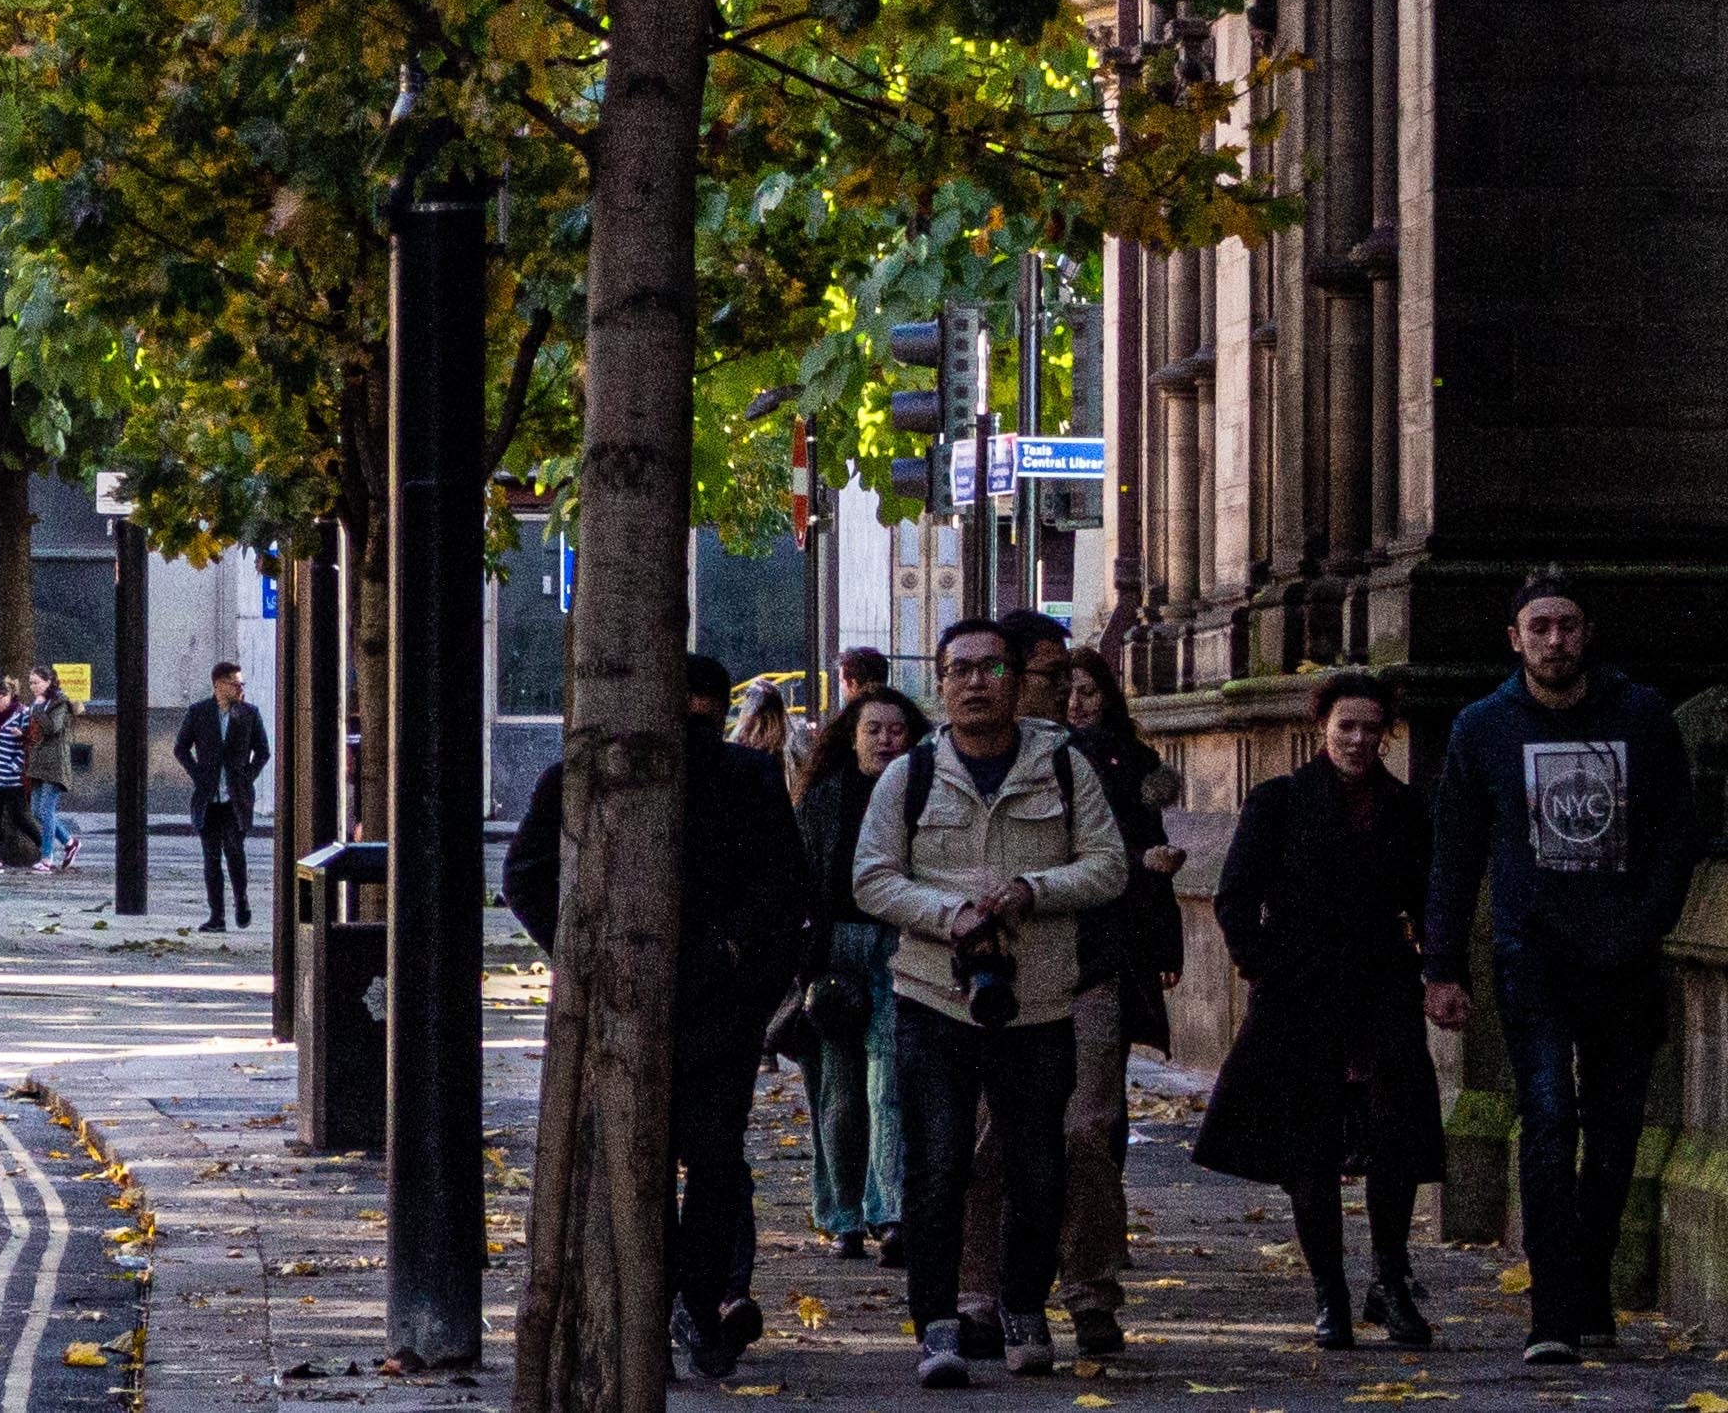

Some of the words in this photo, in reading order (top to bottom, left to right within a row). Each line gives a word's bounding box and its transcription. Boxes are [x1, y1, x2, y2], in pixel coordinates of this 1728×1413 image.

[1022, 444, 1053, 456] Taxis
[1022, 456, 1066, 469] Central
[1069, 457, 1104, 469] Librar
[1552, 793, 1605, 819] NYC
